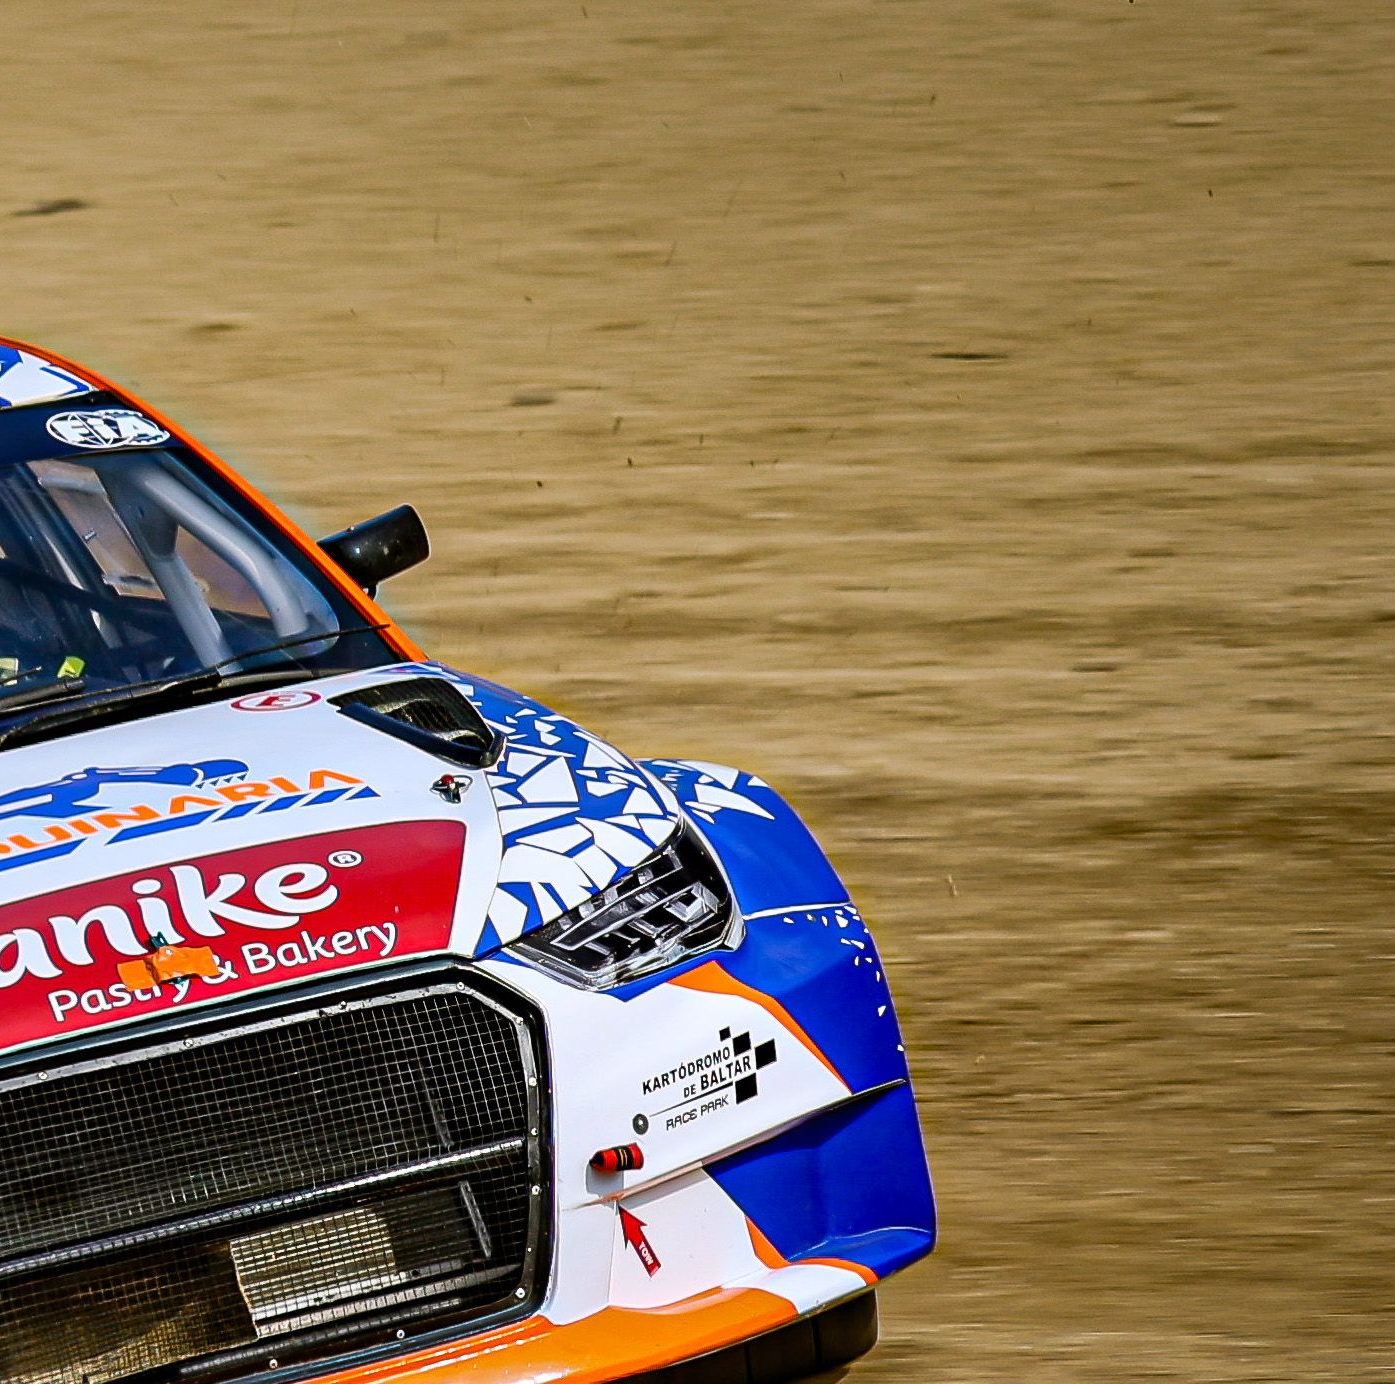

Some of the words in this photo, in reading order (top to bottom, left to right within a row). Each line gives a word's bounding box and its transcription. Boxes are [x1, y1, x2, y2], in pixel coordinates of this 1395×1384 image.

[242, 921, 398, 976] Bakery
[642, 1046, 731, 1095] KARTÓDROMO
[683, 1083, 697, 1099] DE
[700, 1055, 752, 1091] BALTAR
[666, 1108, 698, 1131] RACE
[700, 1094, 729, 1117] PARK
[638, 1240, 654, 1266] TOW
